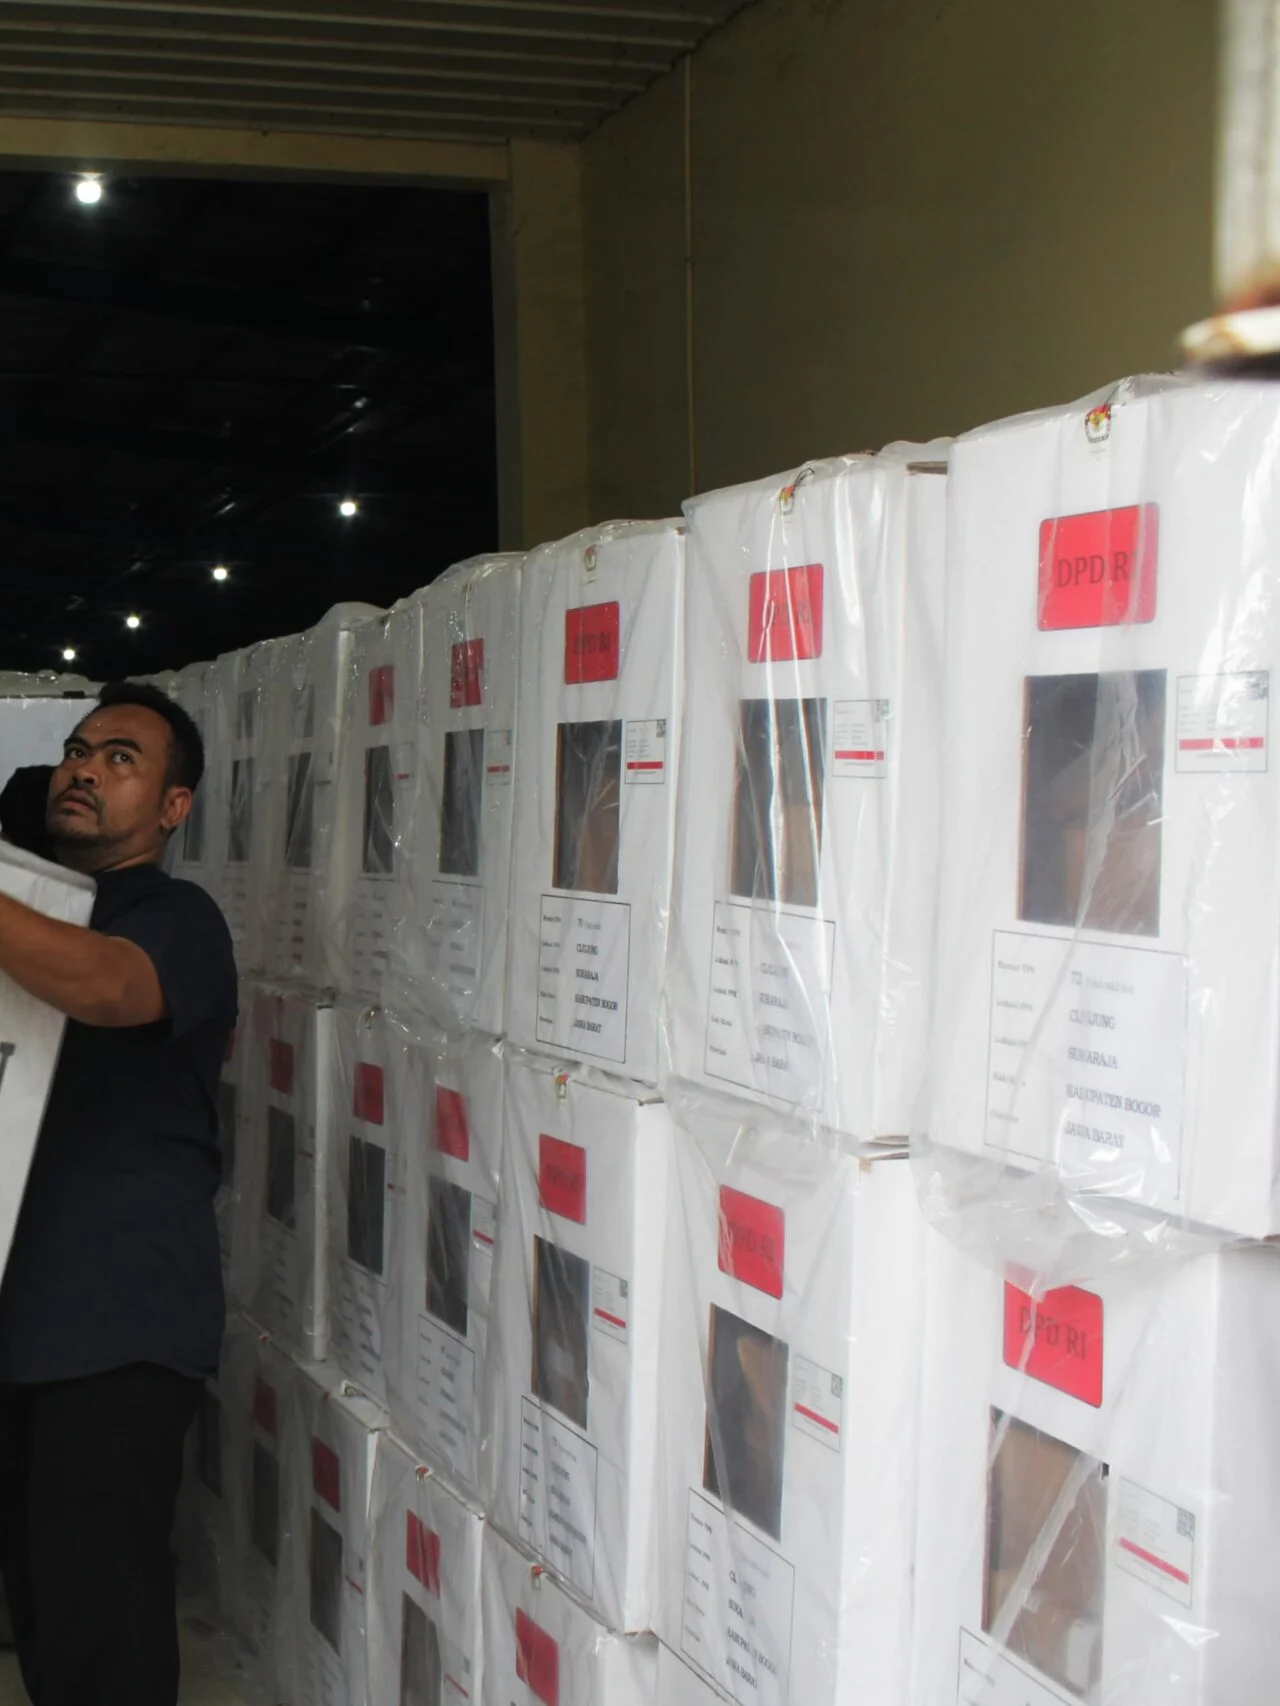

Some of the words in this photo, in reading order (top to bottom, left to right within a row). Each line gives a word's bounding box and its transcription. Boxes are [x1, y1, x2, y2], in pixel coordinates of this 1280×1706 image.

[1057, 554, 1105, 588] DPD
[1114, 550, 1133, 582] R
[1124, 1097, 1162, 1119] BOGOR
